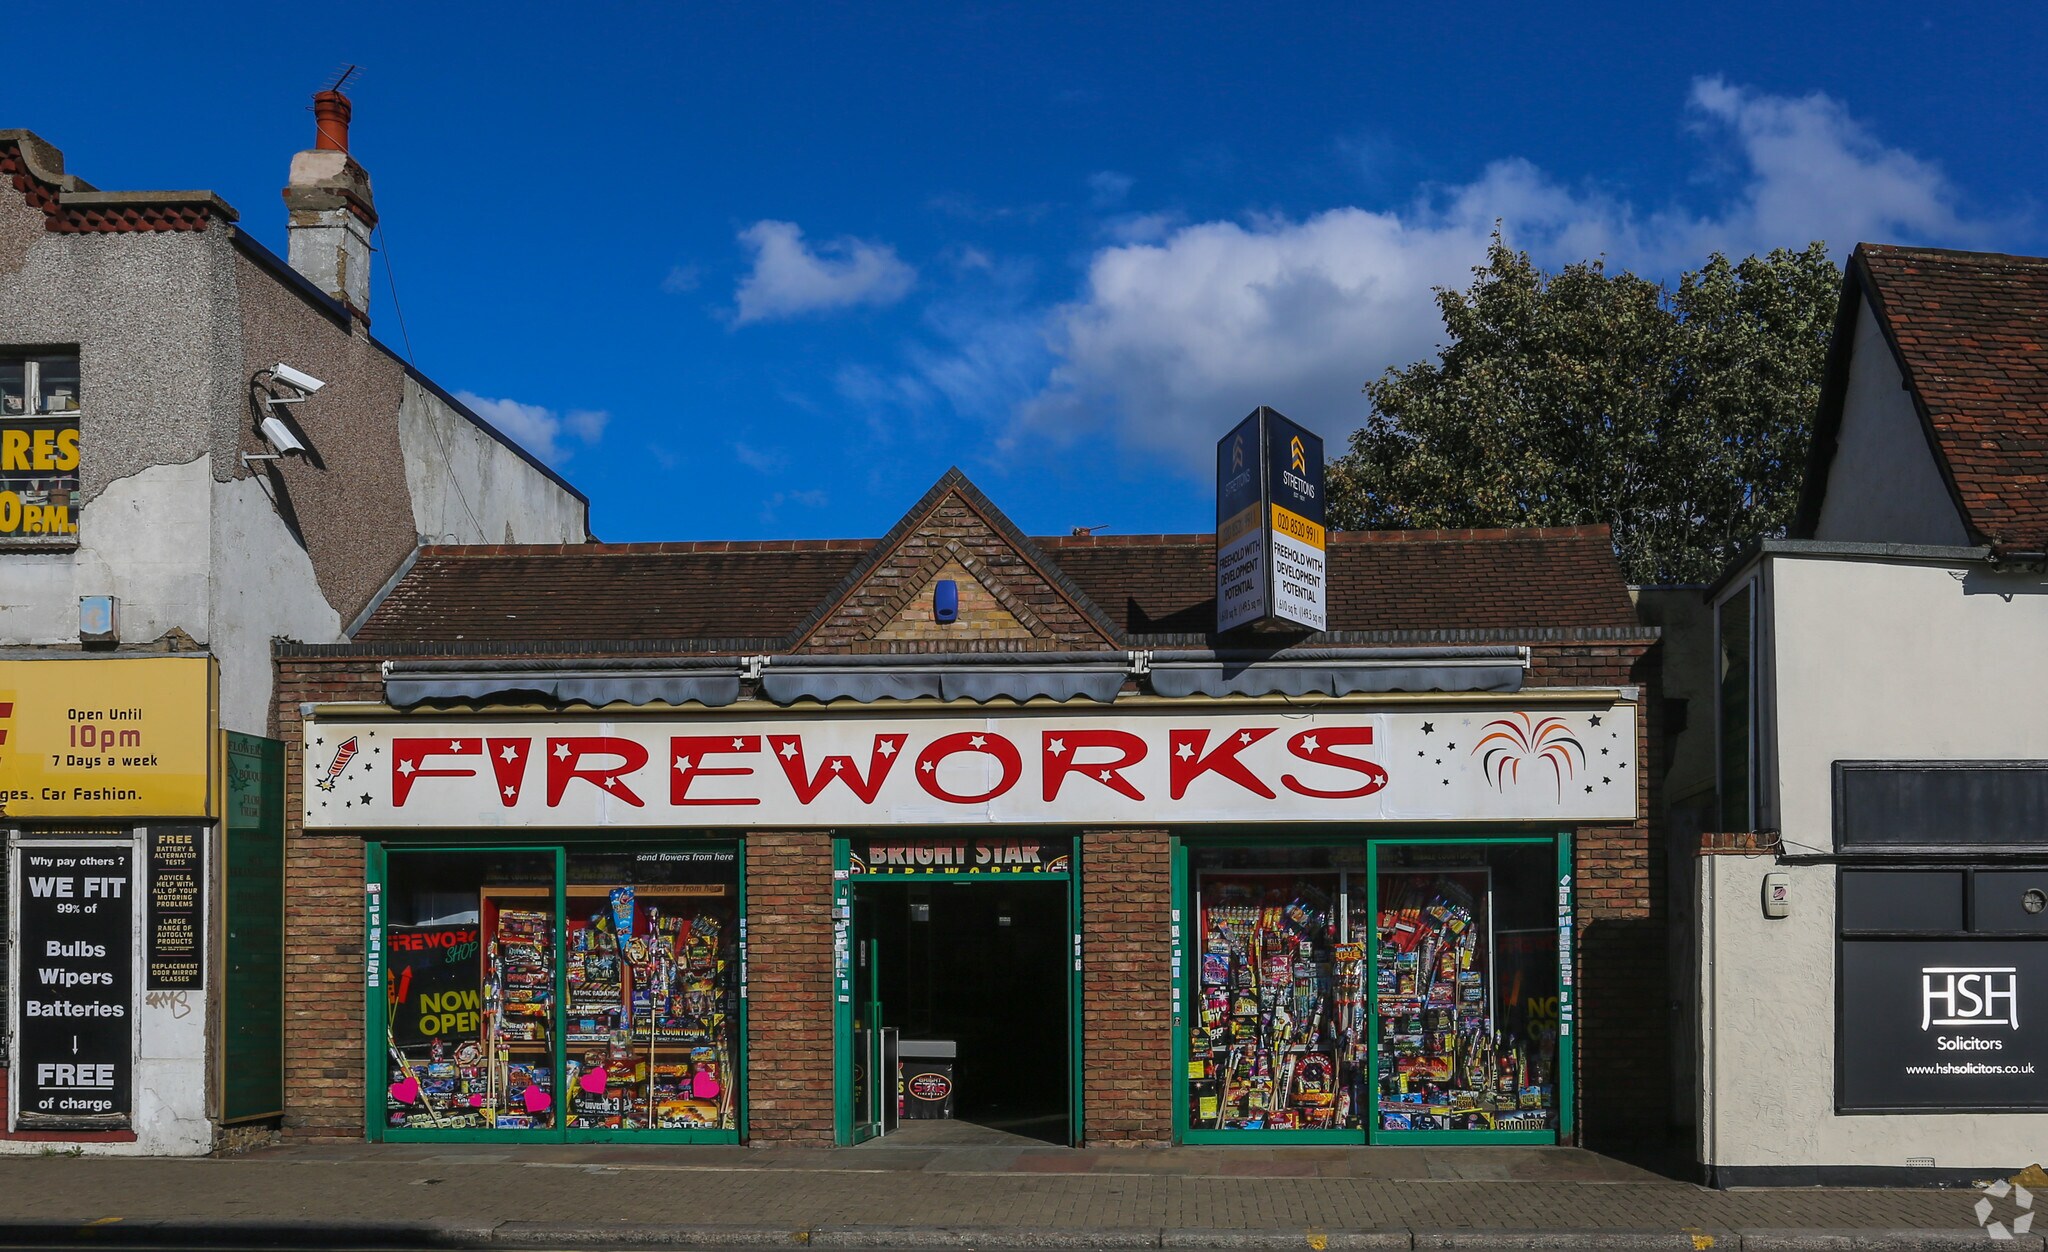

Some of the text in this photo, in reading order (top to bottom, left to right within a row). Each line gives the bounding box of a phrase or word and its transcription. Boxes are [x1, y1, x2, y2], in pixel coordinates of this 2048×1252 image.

[1283, 470, 1315, 499] STRETTONS
[1278, 512, 1319, 545] 020 8520 9911
[1219, 539, 1261, 571] FREEHOLD WITH
[1274, 541, 1323, 573] FREEHOLD WITH
[1220, 557, 1258, 587] DEVELOPMENT
[1276, 560, 1321, 588] DEVELOPMENT
[1225, 578, 1254, 601] POTENTIAL
[1282, 579, 1317, 604] POTENTIAL
[68, 708, 143, 722] Open Until
[70, 725, 141, 753] 10pm
[52, 755, 158, 769] 7 Days a week
[392, 726, 1389, 808] FIREWORKS
[41, 788, 67, 801] Car
[73, 787, 143, 801] Fashion.
[158, 835, 193, 845] FREE
[30, 856, 125, 867] Why pay others ?
[636, 853, 734, 862] send flowers from here
[869, 838, 1042, 865] BRIGHT STAR
[28, 877, 126, 898] WE FIT
[57, 904, 98, 914] 99% of
[46, 940, 106, 957] Bulbs
[445, 941, 479, 963] SHOP
[38, 968, 114, 988] Wipers
[26, 1000, 125, 1017] Batteries
[420, 990, 480, 1014] NOW
[1921, 974, 2019, 1031] HSH
[419, 1011, 480, 1036] OPEN
[661, 1027, 706, 1037] COUNTDOWN
[1937, 1036, 2002, 1050] Solicitors
[37, 1063, 115, 1086] FREE
[1906, 1063, 2035, 1074] www.hshsolicitors.co.uk
[38, 1098, 112, 1111] of charge
[663, 1121, 713, 1129] BATTLE
